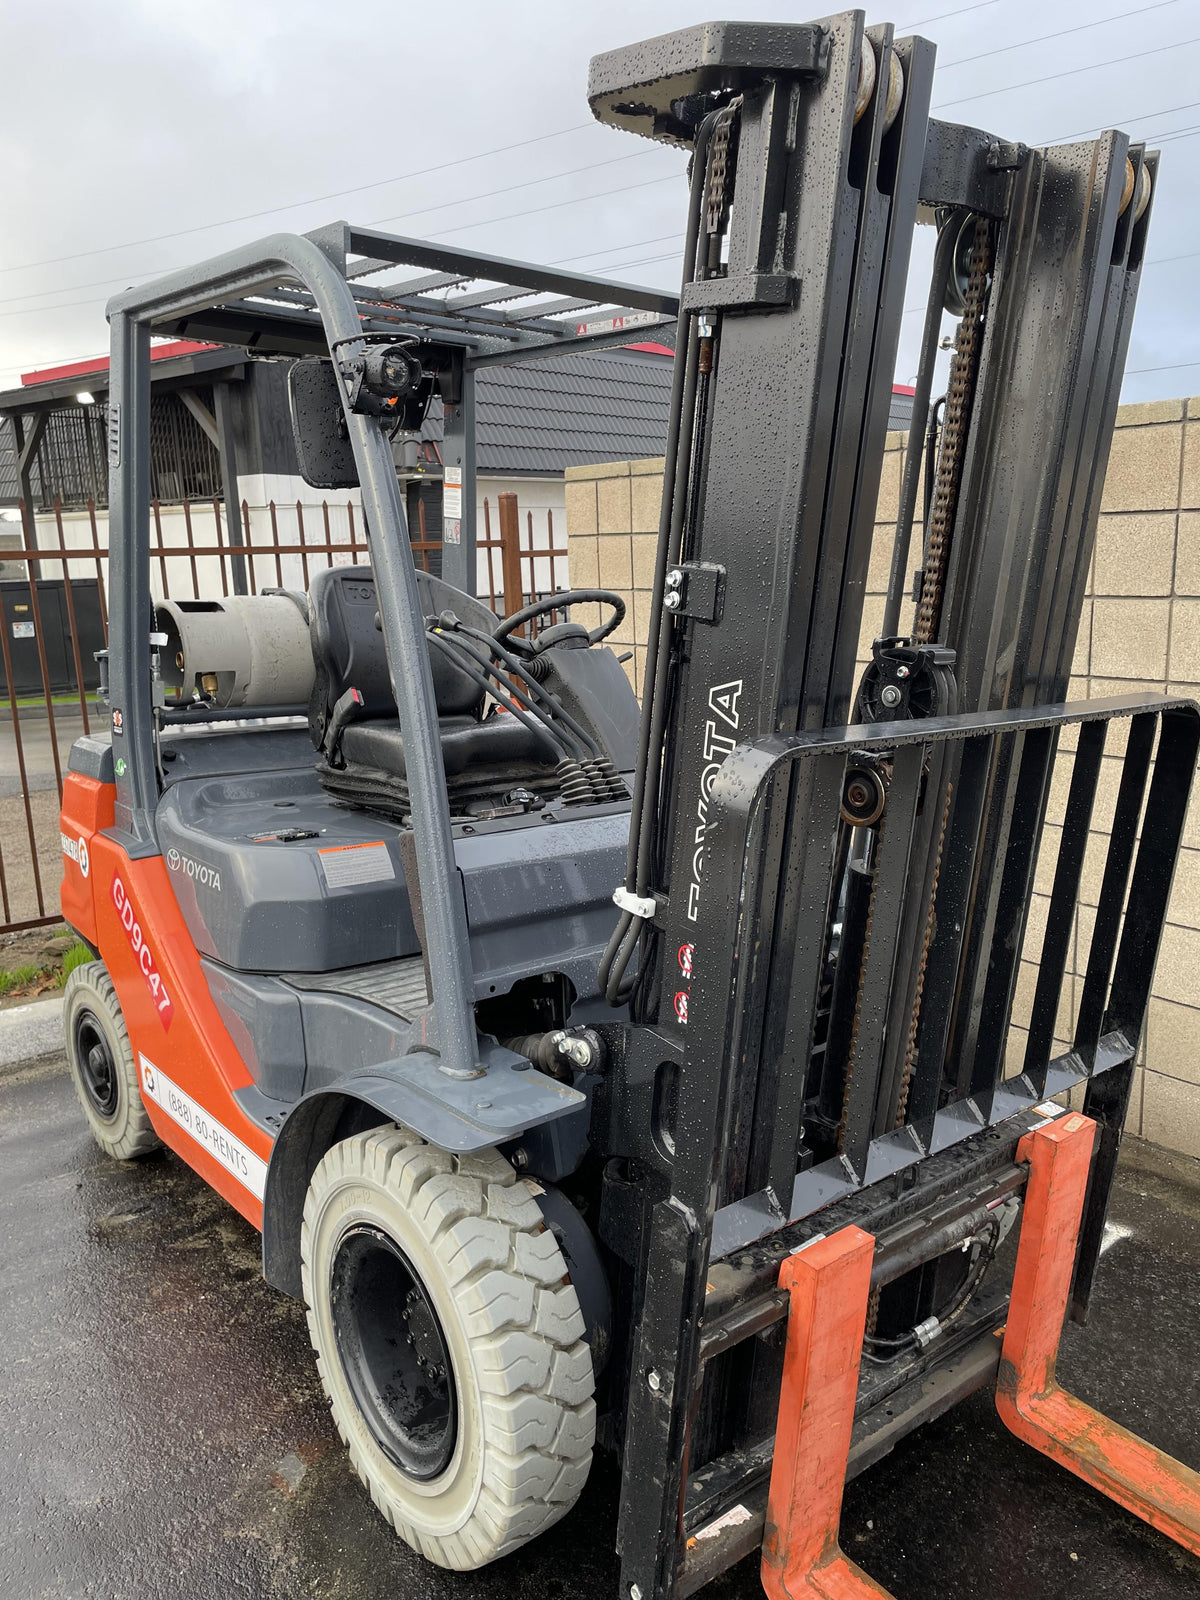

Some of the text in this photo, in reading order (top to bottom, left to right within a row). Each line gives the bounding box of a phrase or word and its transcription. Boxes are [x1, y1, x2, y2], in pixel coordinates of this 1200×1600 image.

[181, 856, 221, 891] TOYOTA
[113, 877, 171, 1012] GD9C47
[168, 1089, 248, 1176] (888) 80-RENTS
